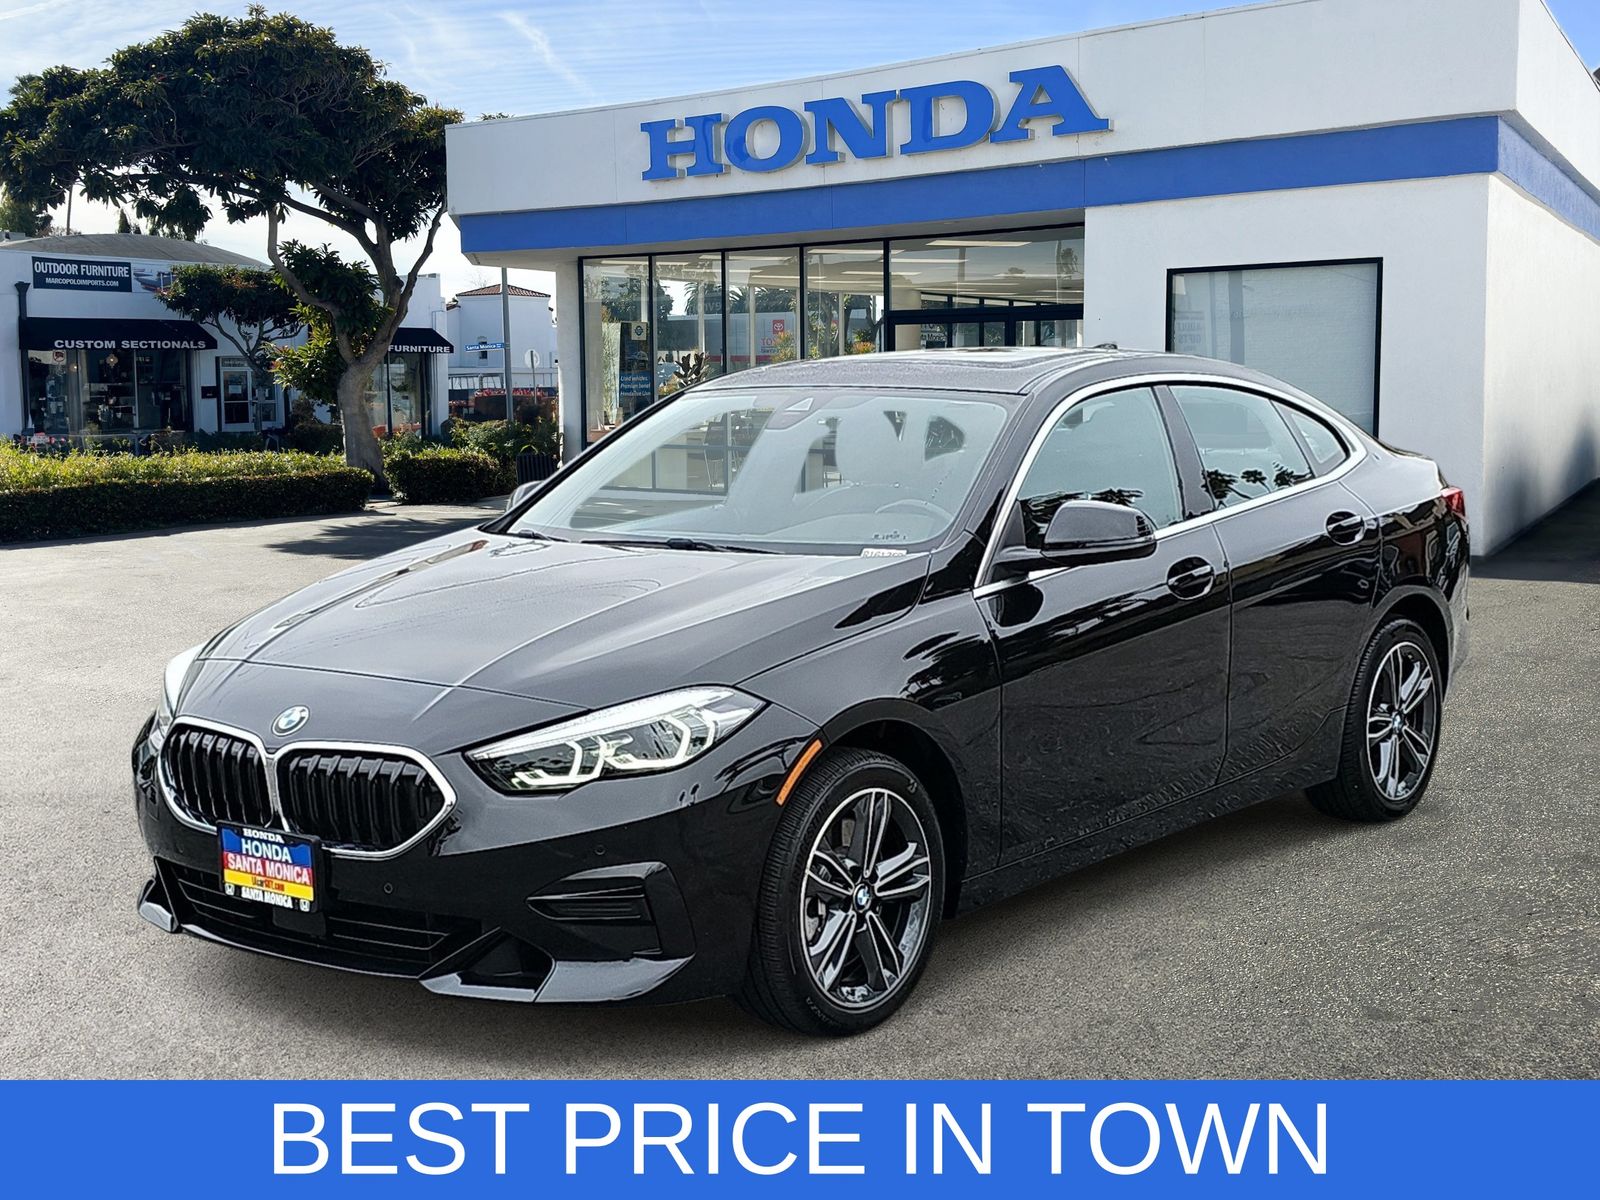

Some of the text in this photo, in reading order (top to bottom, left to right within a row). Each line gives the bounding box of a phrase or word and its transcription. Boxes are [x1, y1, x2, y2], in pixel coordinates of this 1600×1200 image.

[641, 64, 1111, 181] HONDA
[34, 261, 130, 278] OUTDOOR FURNITURE
[45, 277, 119, 287] MARCOPOLOIMPORTS.COM
[54, 340, 206, 349] CUSTOM SECTIONALS
[388, 344, 451, 353] FURNITURE
[243, 828, 285, 844] HONDA
[241, 838, 292, 864] HONDA
[227, 853, 311, 886] SANTA MONICA
[241, 886, 293, 909] SANTA MONICA
